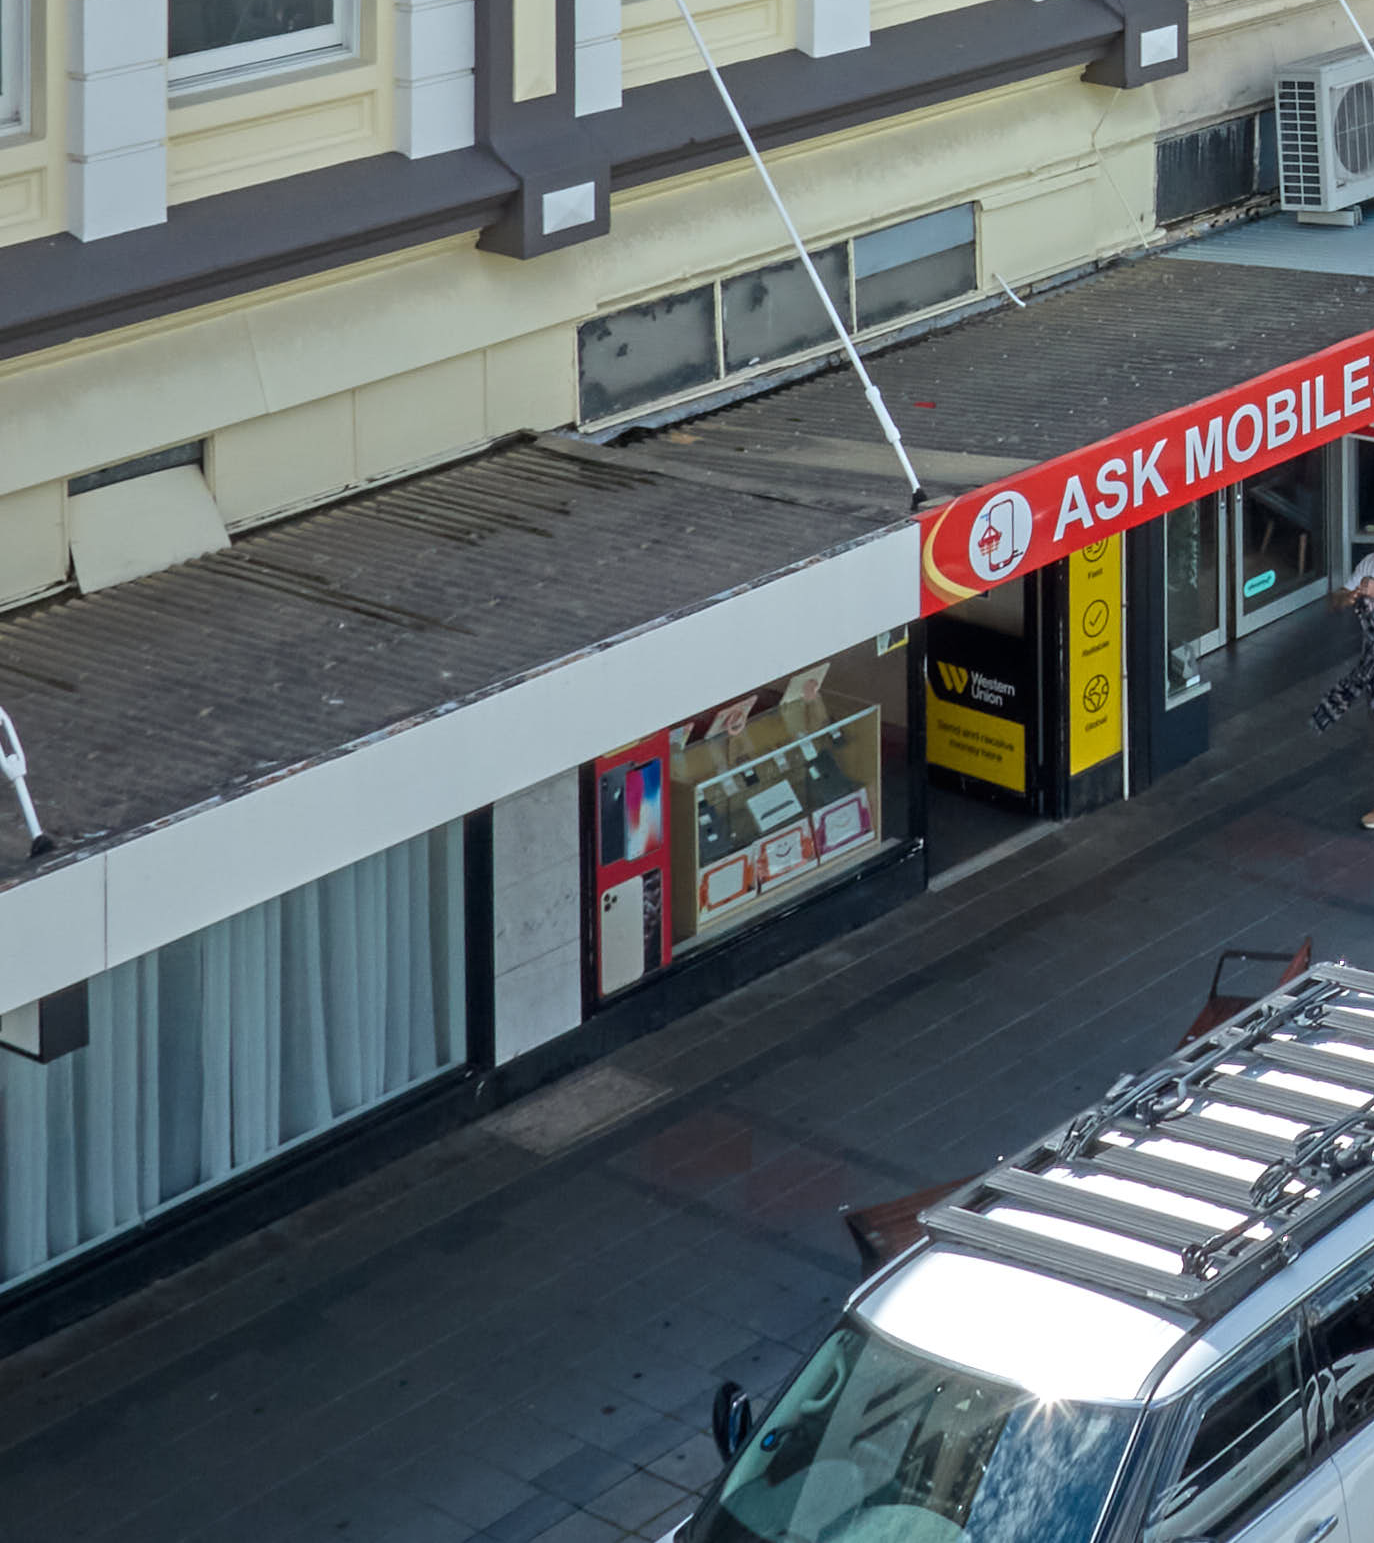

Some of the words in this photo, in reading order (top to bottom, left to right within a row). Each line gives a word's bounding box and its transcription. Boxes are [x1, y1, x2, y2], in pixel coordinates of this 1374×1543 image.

[1053, 438, 1169, 543] ASK
[971, 670, 1016, 697] Western
[971, 685, 1003, 706] Union
